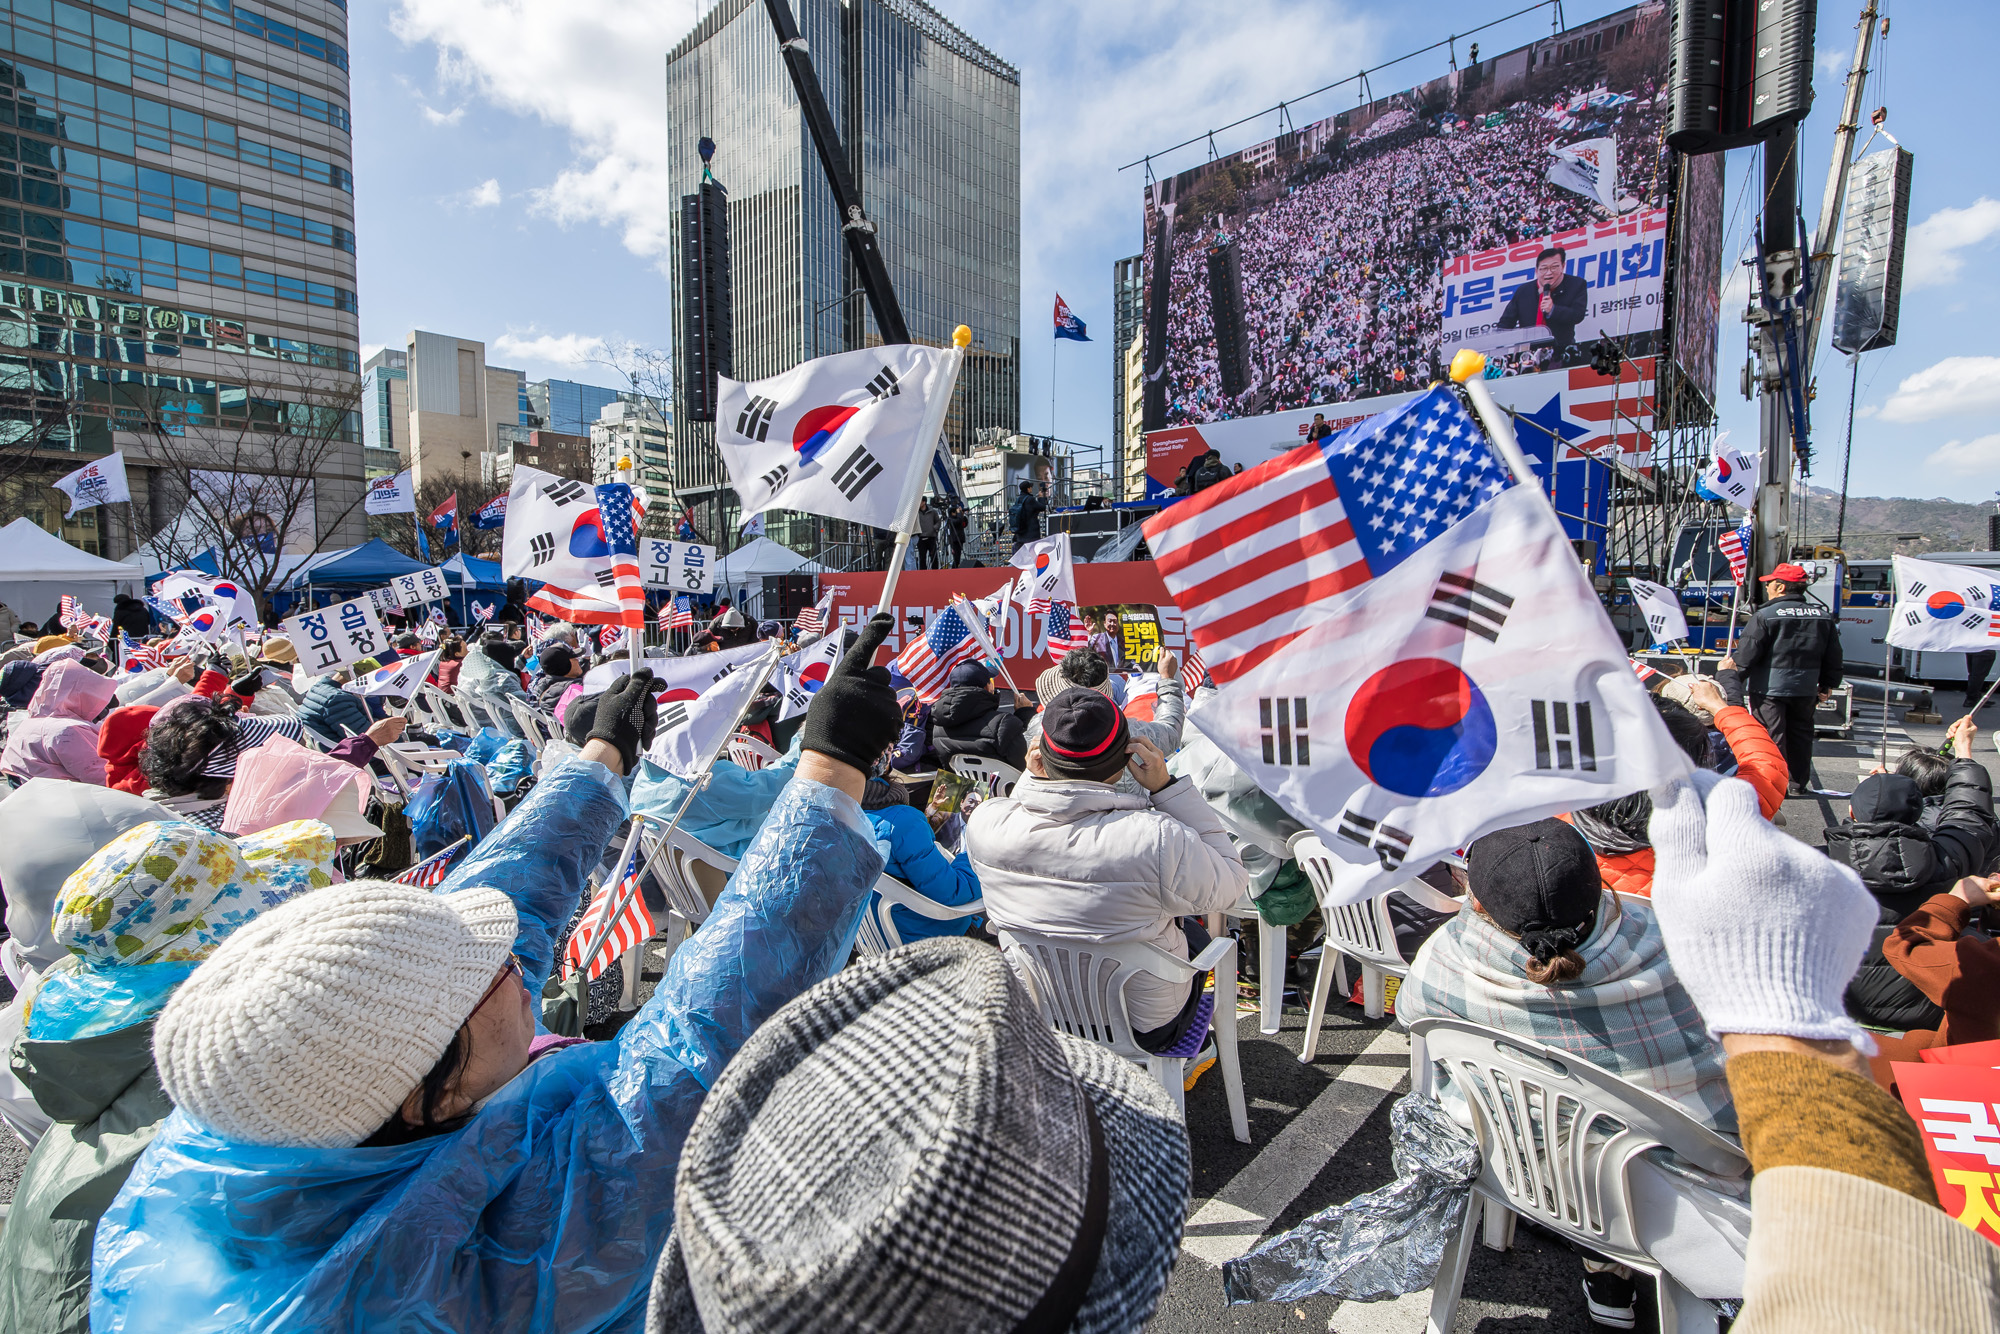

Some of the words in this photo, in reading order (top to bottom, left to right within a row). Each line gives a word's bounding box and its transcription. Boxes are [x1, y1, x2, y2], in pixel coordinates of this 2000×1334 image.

[651, 541, 705, 568] 정읍
[399, 571, 438, 590] 정읍
[648, 564, 706, 590] 고창
[405, 584, 442, 605] 고창
[299, 603, 367, 641] 정읍
[1122, 622, 1160, 643] 탄핵
[311, 628, 375, 669] 고창
